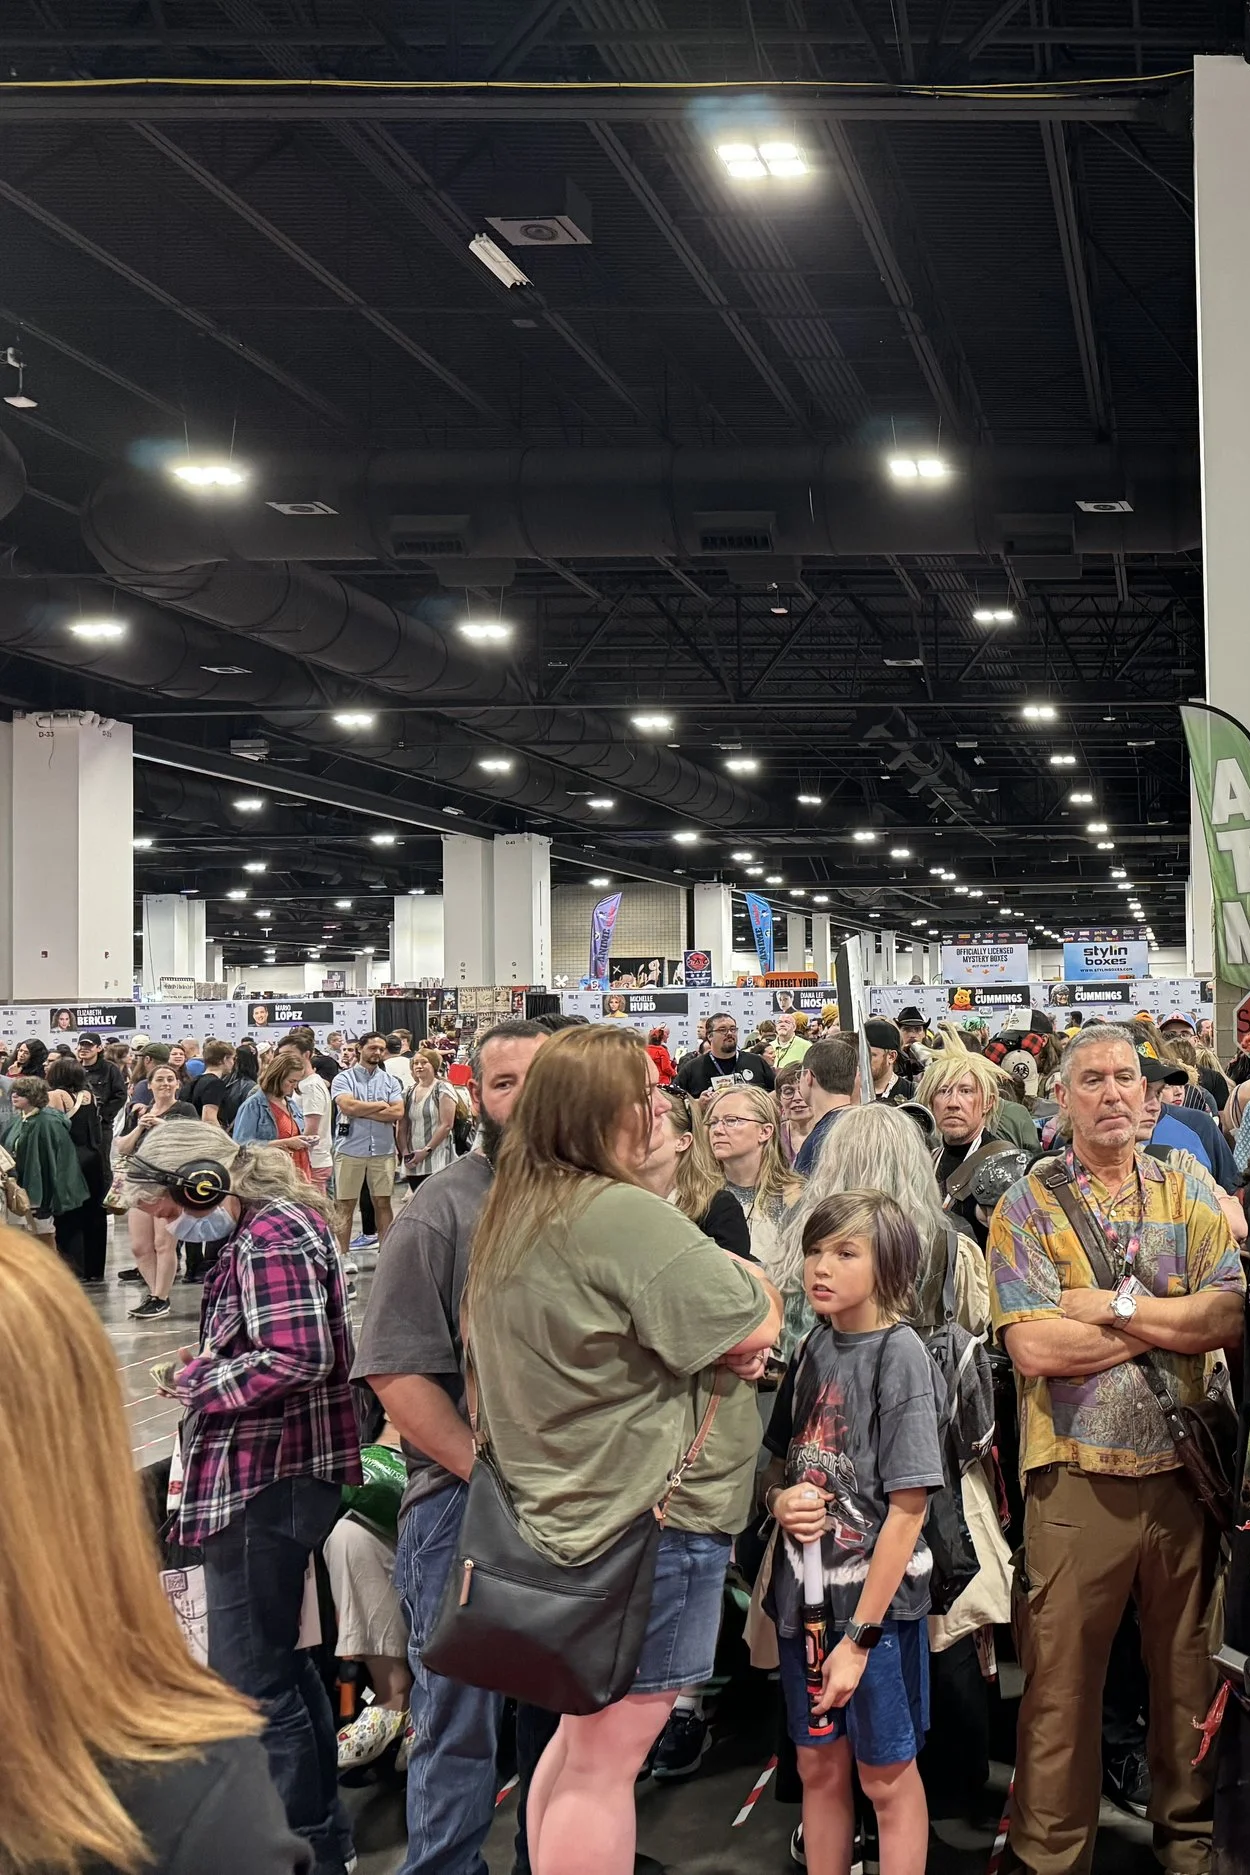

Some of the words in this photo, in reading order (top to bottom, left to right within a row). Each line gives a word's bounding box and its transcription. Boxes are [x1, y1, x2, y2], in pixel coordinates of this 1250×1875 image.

[956, 947, 987, 956] OFFICIALLY
[1083, 944, 1128, 958] stylin
[962, 955, 989, 963] MYSTERY
[1085, 957, 1127, 966] boxes
[765, 979, 797, 988] PROTECT
[798, 978, 818, 988] YOUR
[975, 988, 984, 996] JIM
[1074, 985, 1084, 993] JIM
[975, 993, 1023, 1005] CUMMINGS
[1074, 990, 1122, 1002] CUMMINGS
[629, 1002, 656, 1012] HURD
[77, 1015, 118, 1026] BERKLEY
[275, 1011, 303, 1021] LOPEZ
